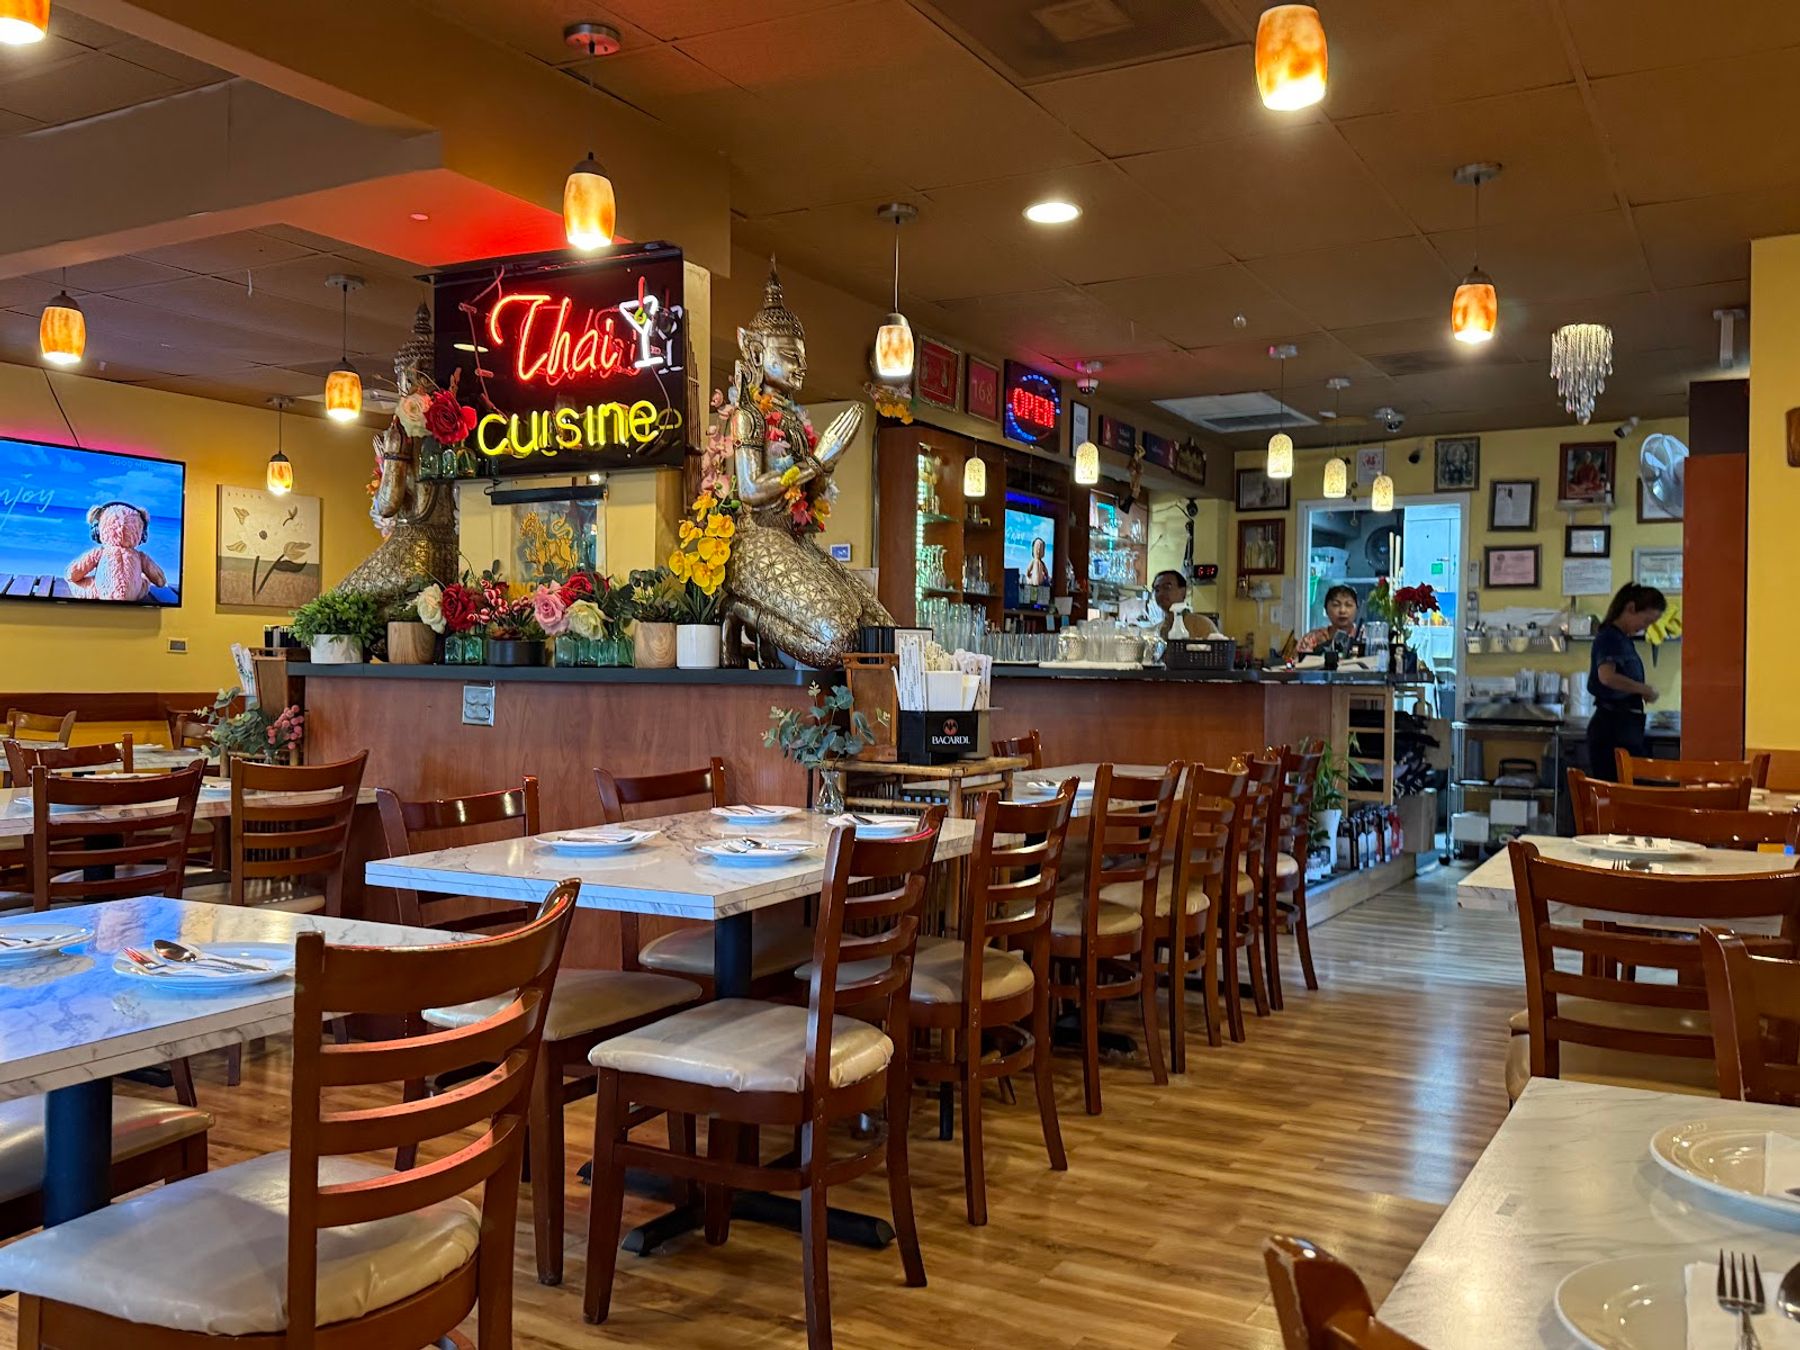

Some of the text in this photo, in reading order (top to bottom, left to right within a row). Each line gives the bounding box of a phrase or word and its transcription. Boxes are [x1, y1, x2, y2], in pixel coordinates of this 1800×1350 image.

[490, 294, 619, 380] Thai
[974, 379, 993, 405] 168
[1013, 387, 1056, 429] OPEN
[477, 400, 660, 456] cuisine
[0, 486, 55, 529] njoy
[931, 735, 970, 745] BACARDI
